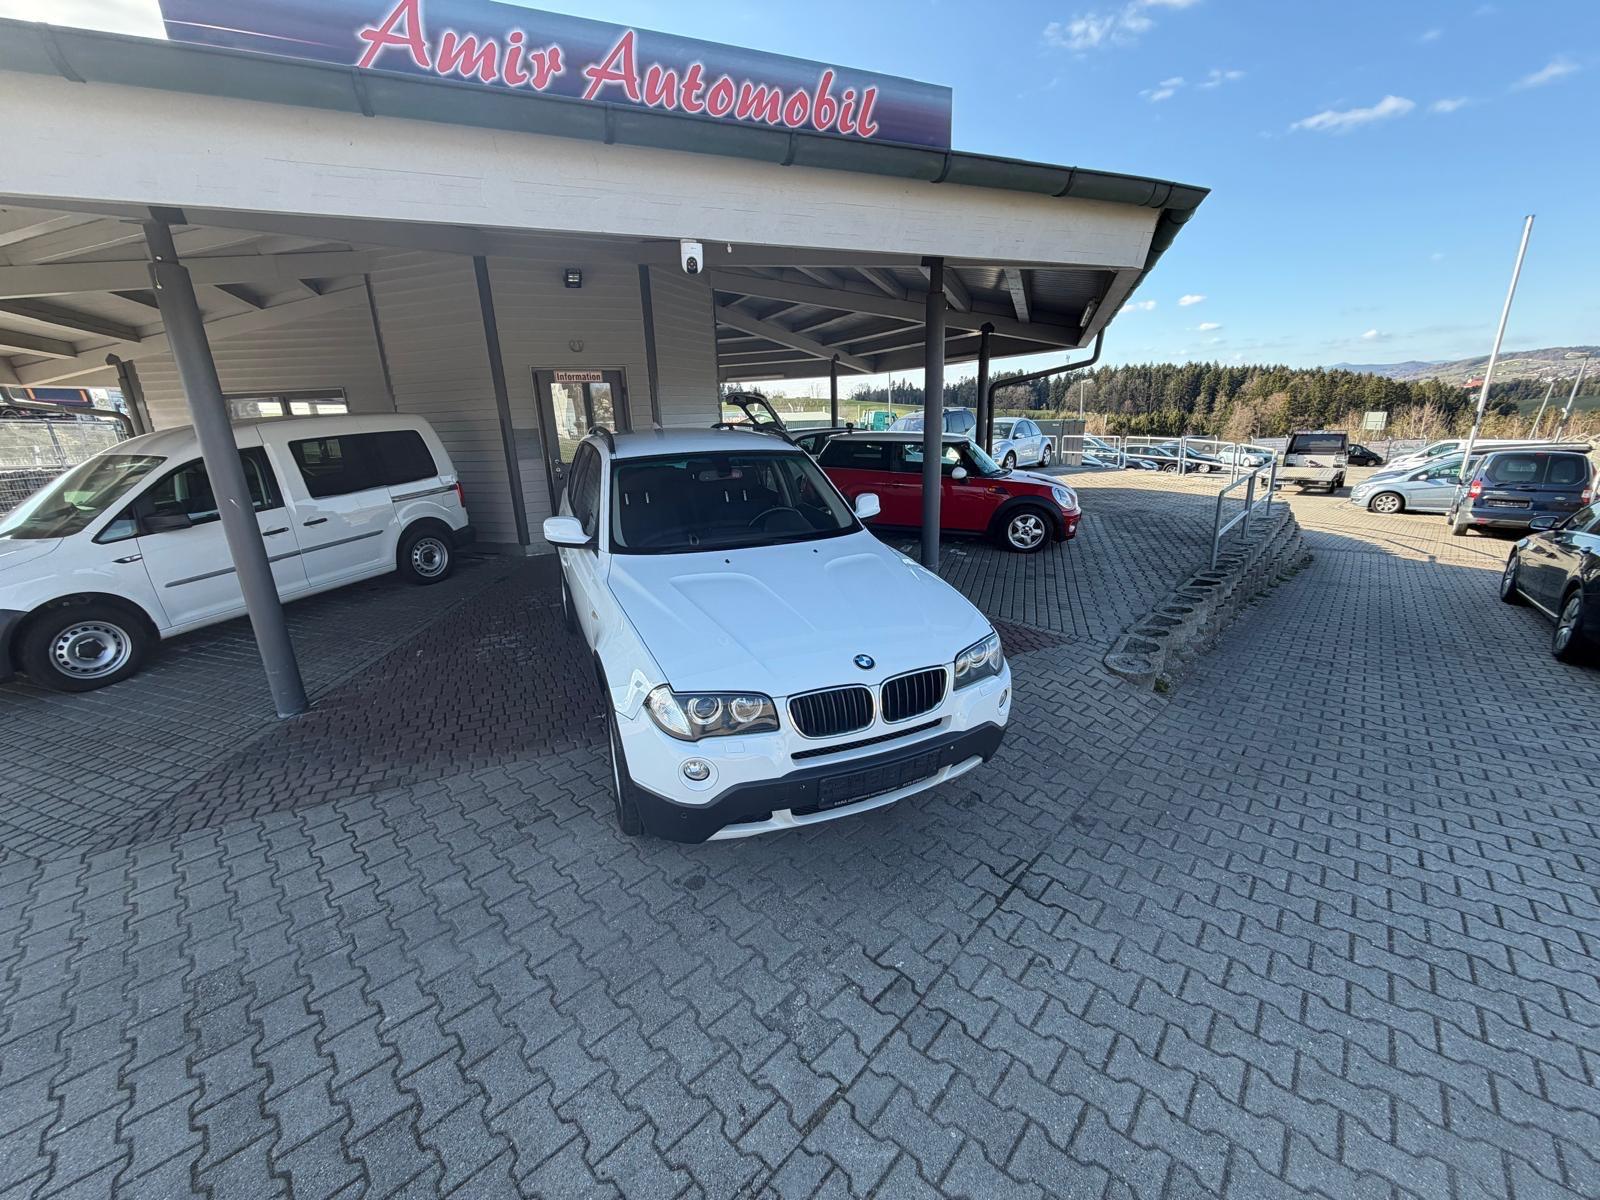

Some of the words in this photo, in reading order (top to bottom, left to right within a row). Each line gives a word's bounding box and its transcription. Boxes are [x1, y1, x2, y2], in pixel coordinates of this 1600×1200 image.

[356, 0, 563, 91] Amir
[582, 28, 878, 138] Automobil
[556, 372, 601, 381] Information
